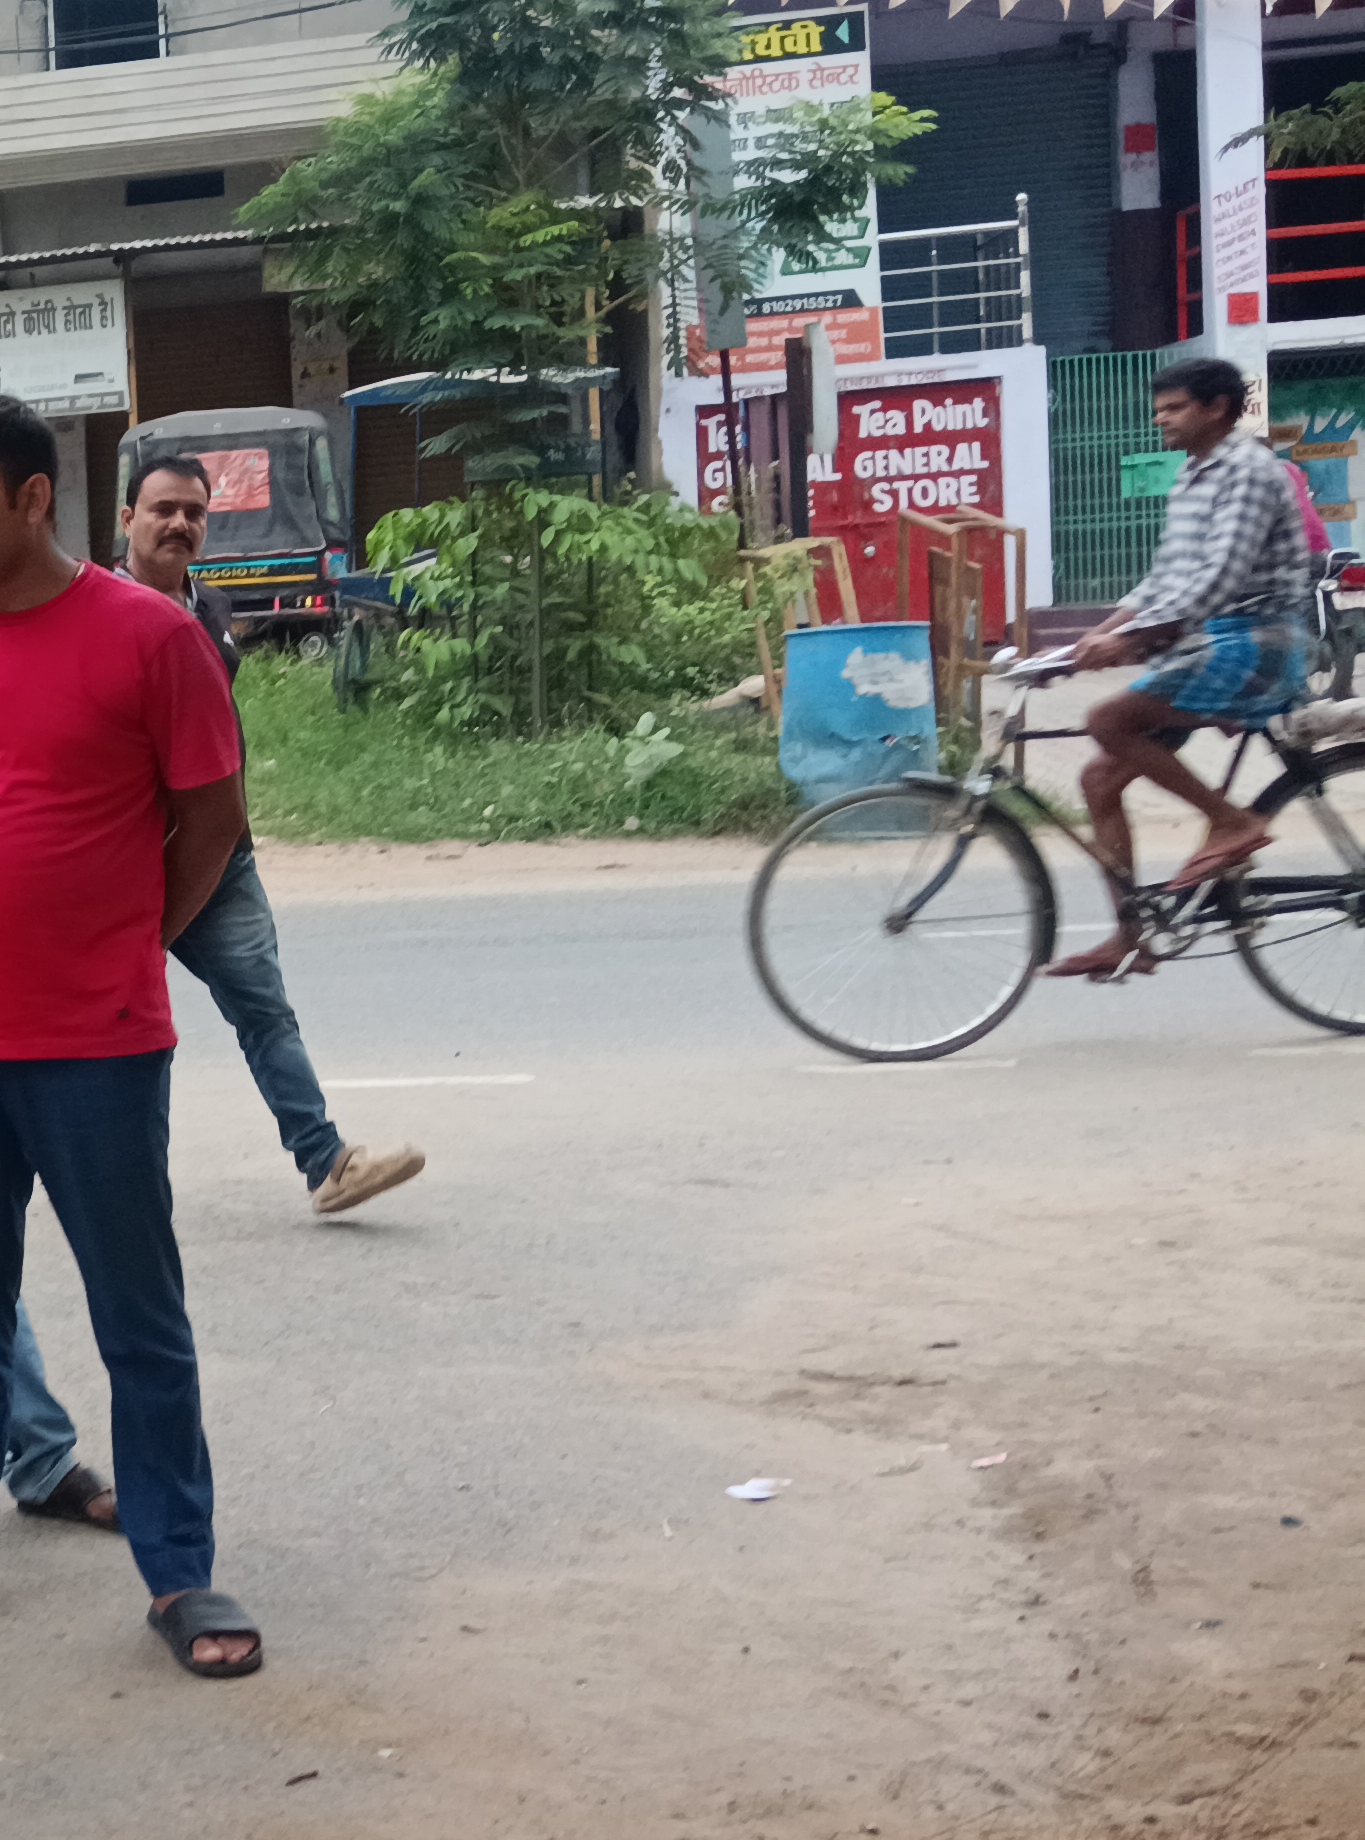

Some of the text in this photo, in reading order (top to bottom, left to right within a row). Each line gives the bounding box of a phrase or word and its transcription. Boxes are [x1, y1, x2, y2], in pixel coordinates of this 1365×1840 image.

[807, 62, 860, 90] सेन्टर
[22, 300, 57, 336] कॉपी
[62, 297, 93, 332] होता
[851, 397, 989, 439] Tea Point
[853, 441, 990, 480] GENERAL
[870, 474, 981, 513] STORE
